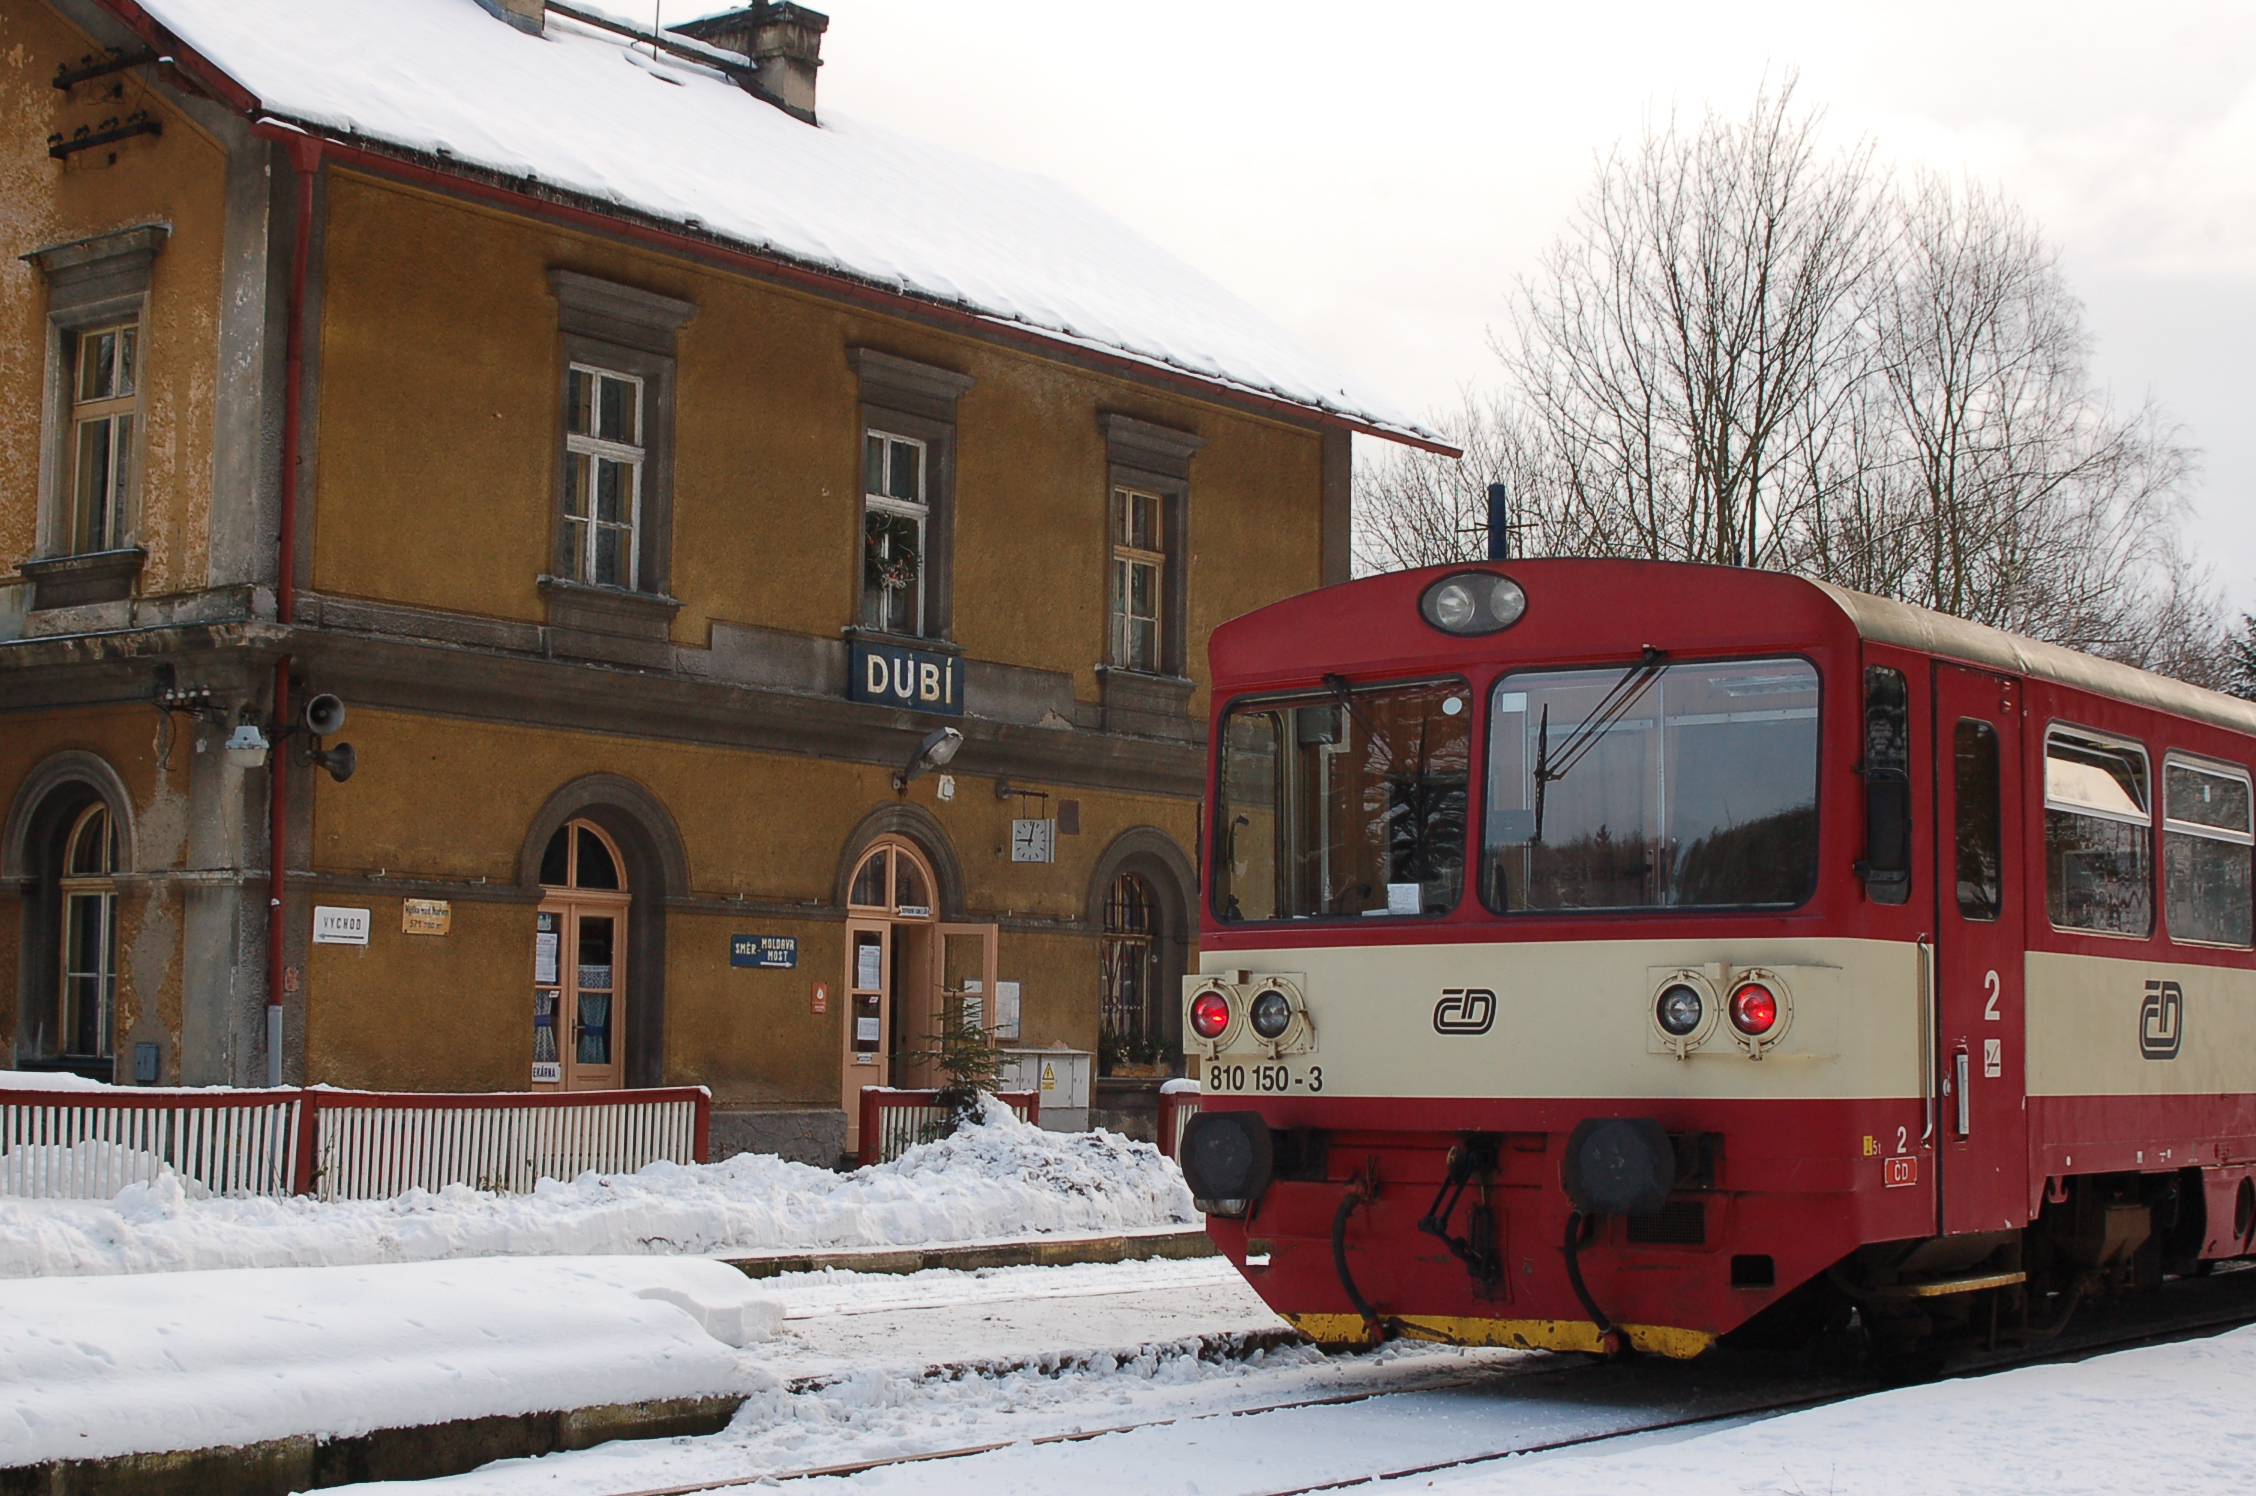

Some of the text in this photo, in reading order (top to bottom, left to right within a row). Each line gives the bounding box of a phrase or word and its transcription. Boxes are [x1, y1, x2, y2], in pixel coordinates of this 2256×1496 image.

[867, 653, 953, 705] DUBÍ
[323, 913, 362, 931] VÝCHOD
[761, 938, 795, 950] MOLDAVA
[767, 950, 789, 962] MOST
[1984, 969, 2001, 1021] 2
[532, 1065, 556, 1078] EKÁRNA
[1210, 1065, 1245, 1091] 810
[1896, 1126, 1907, 1153] 2
[1894, 1159, 1909, 1182] ČD
